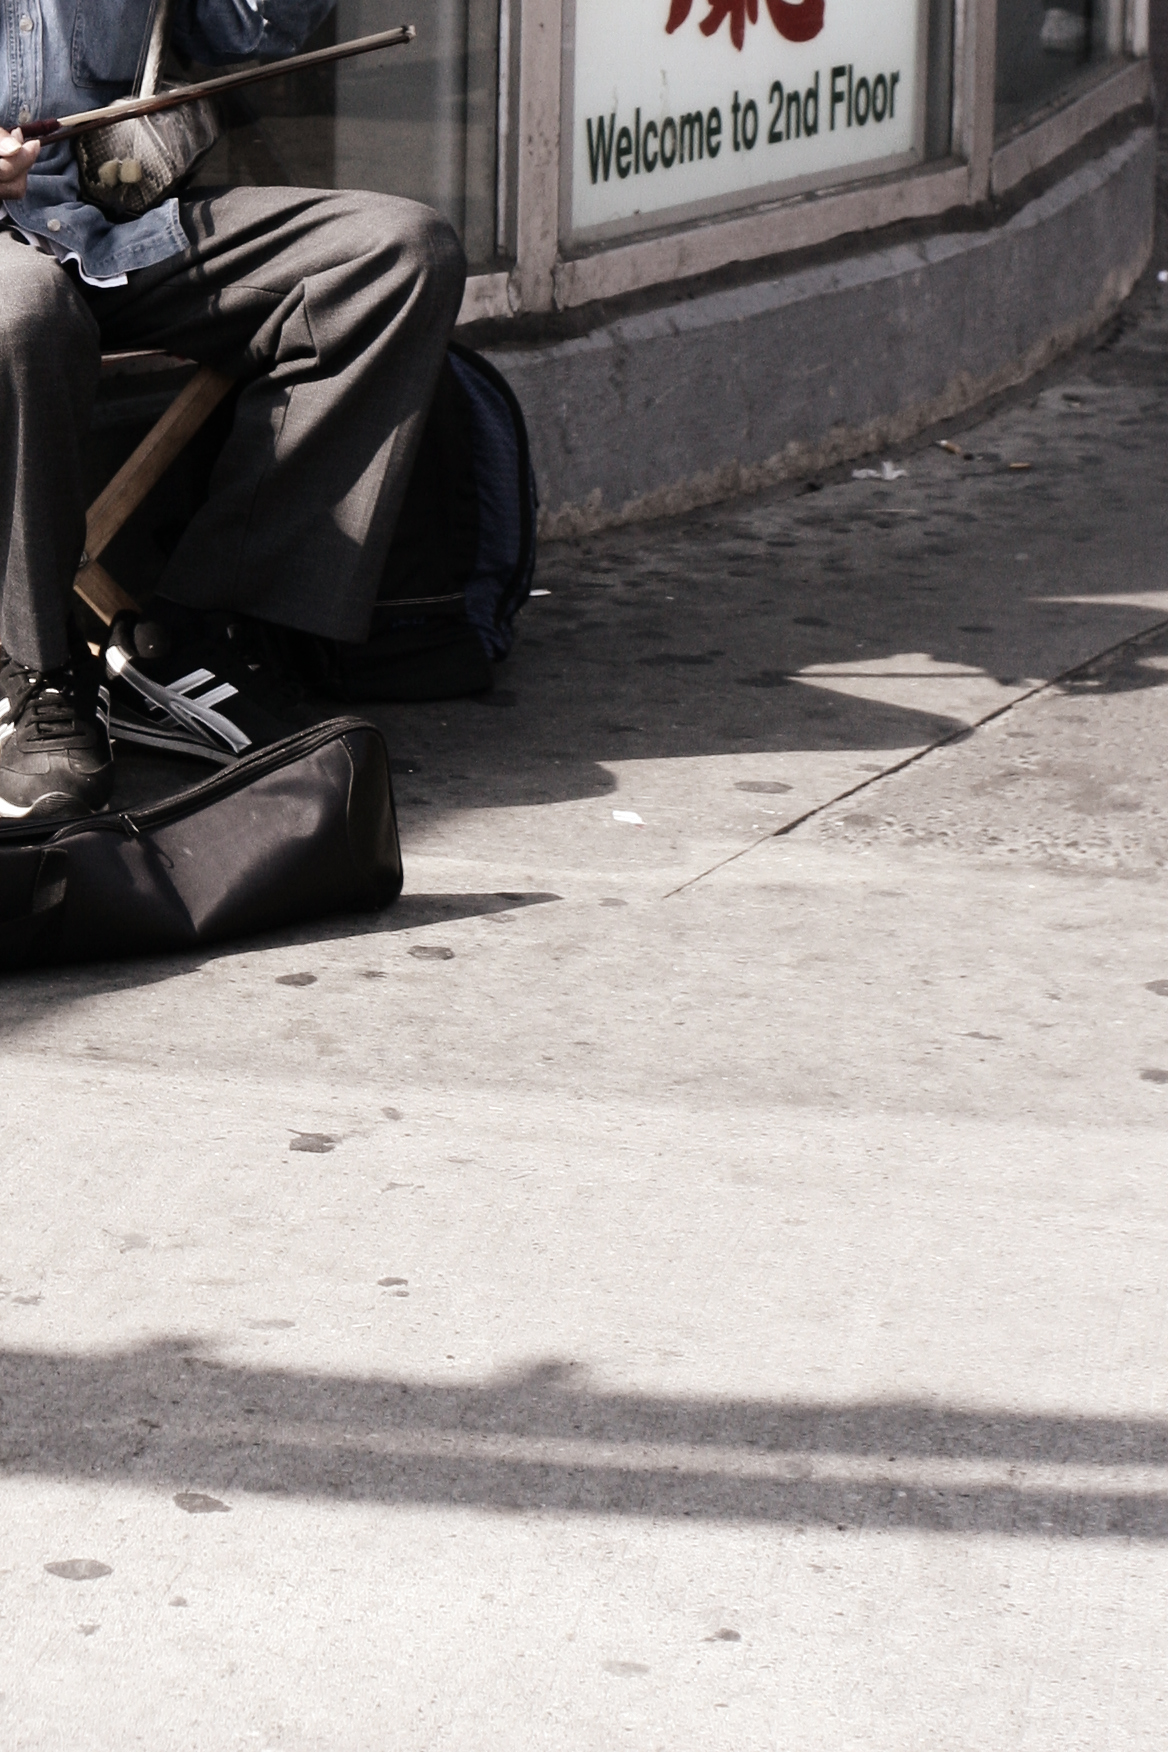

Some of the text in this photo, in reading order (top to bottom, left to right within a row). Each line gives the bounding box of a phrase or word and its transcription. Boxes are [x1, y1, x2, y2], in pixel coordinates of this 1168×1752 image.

[586, 64, 900, 186] Welcome to 2nd Floor
